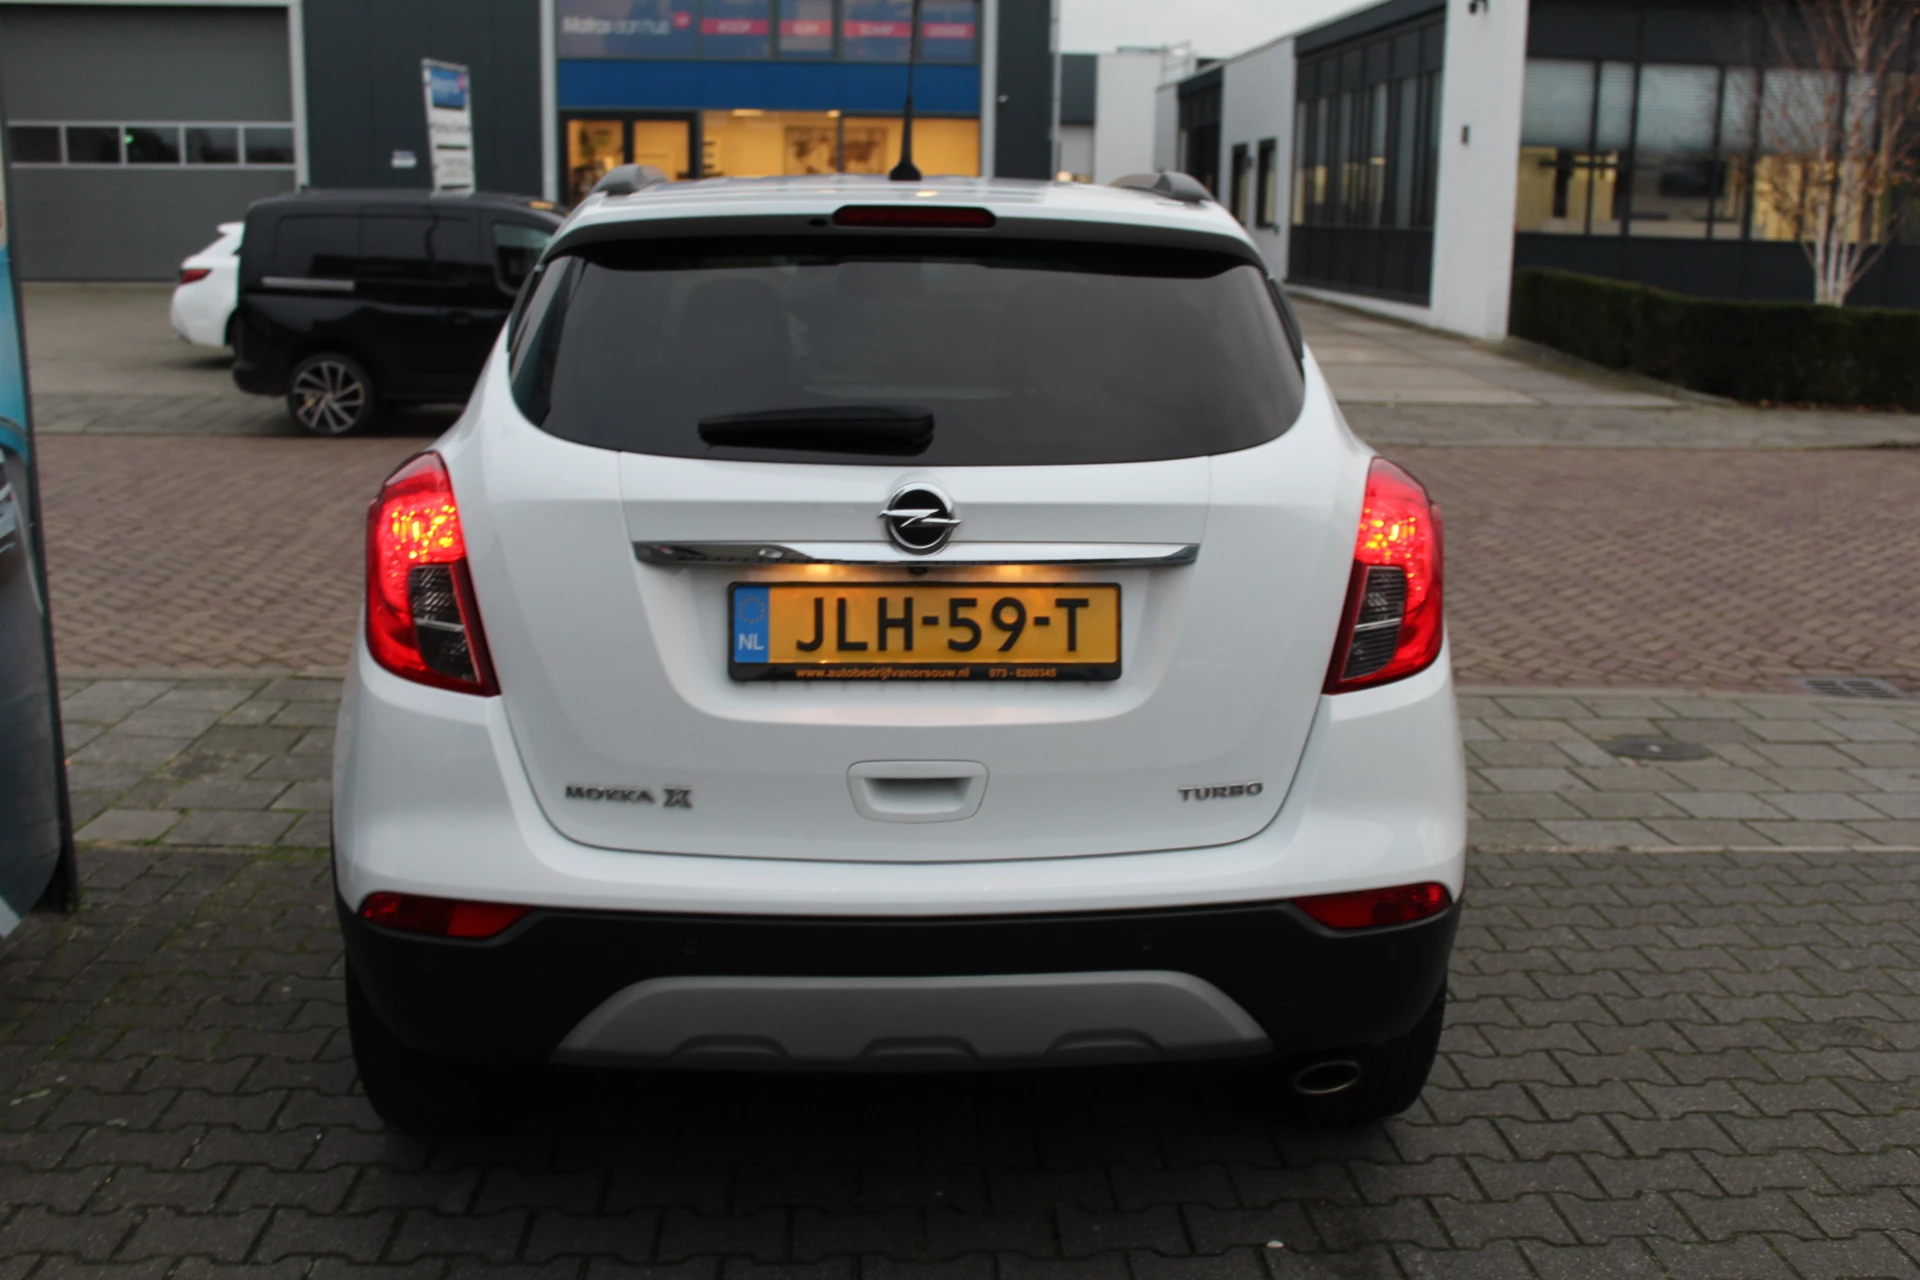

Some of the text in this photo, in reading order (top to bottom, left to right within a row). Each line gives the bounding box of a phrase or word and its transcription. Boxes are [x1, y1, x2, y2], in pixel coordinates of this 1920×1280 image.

[796, 597, 1090, 653] JLH-59-T
[738, 633, 764, 650] NL
[795, 667, 970, 680] www.autobedrijfvanorsouw.nl
[565, 785, 693, 809] MOKKA X
[1178, 781, 1264, 802] TURBO
